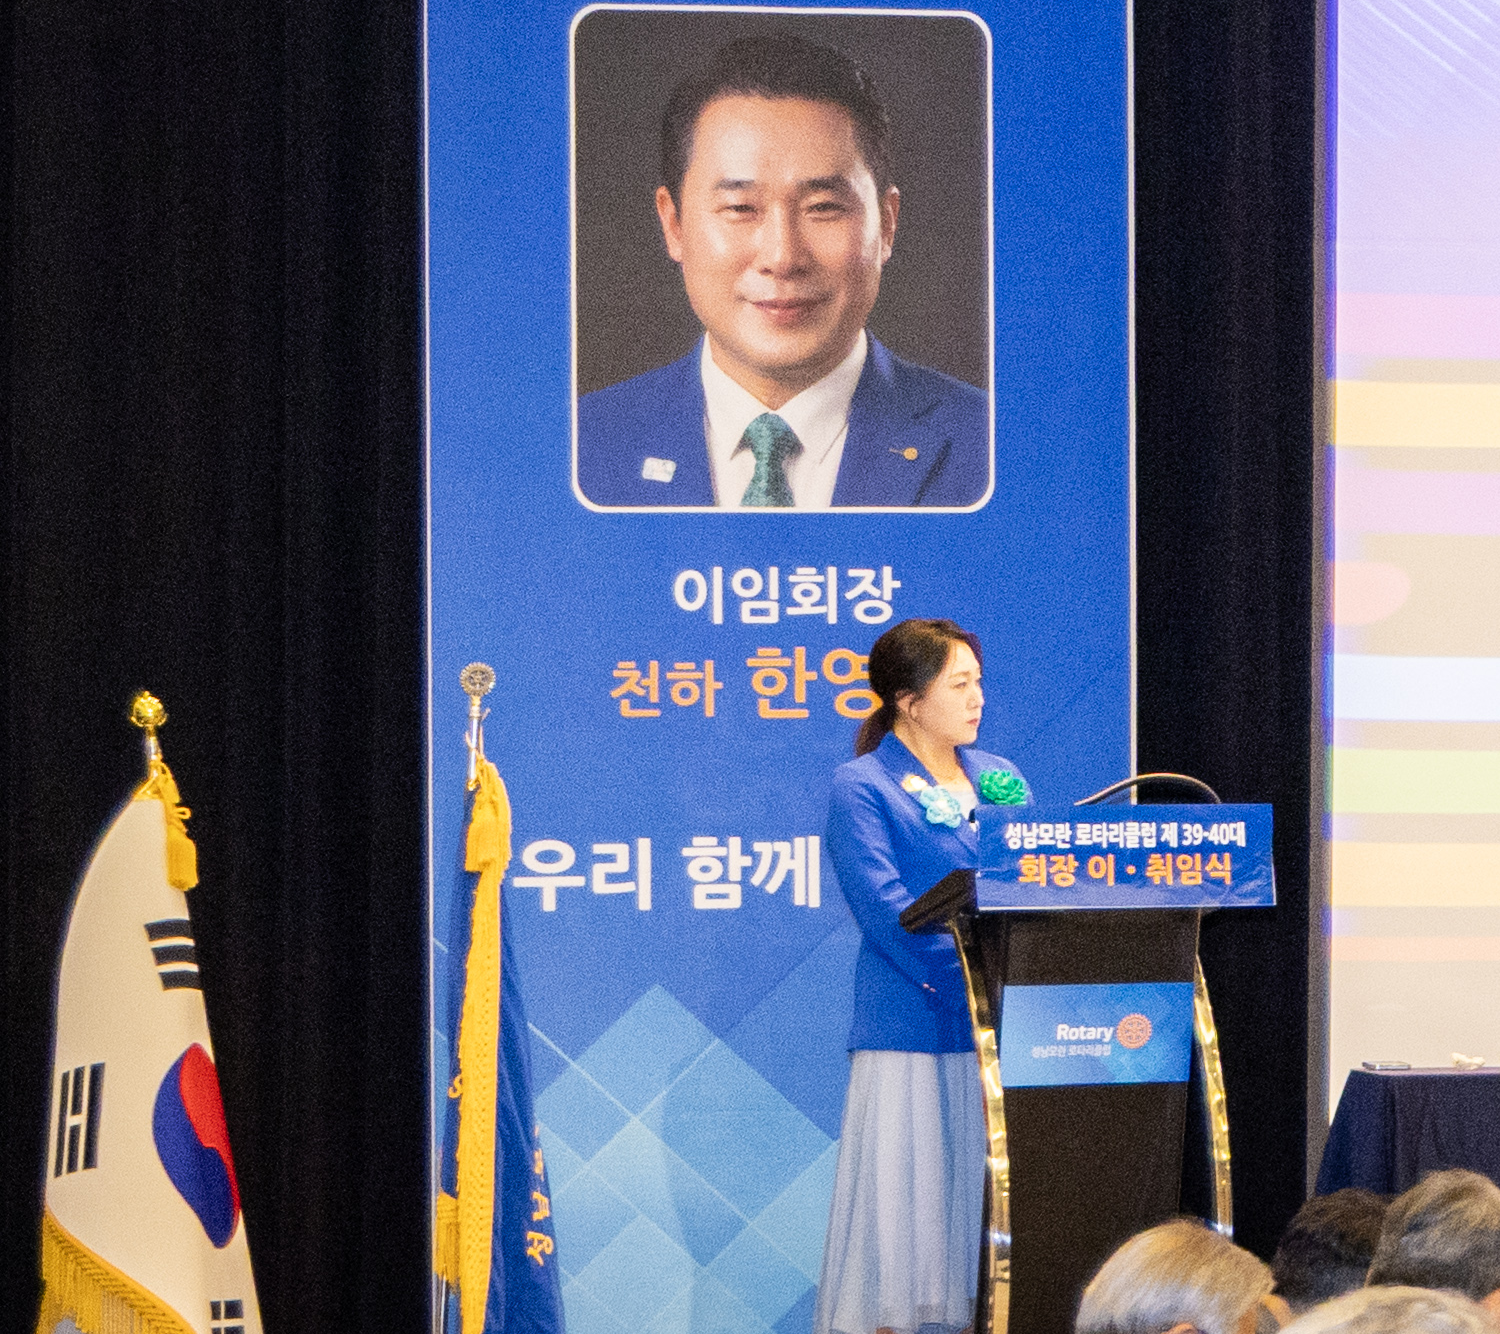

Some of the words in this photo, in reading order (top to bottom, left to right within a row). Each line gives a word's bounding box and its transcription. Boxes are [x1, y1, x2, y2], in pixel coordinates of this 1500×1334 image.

[674, 566, 901, 624] 이임회장
[611, 660, 723, 717] 천하
[746, 647, 882, 719] 한영
[1005, 823, 1072, 849] 성남모란
[1076, 822, 1156, 848] 로타리클럽
[1161, 823, 1177, 847] 제
[1182, 822, 1245, 846] 39-40대
[512, 838, 651, 911] 우리
[682, 836, 820, 909] 함께
[1019, 855, 1077, 886] 회장
[1088, 855, 1114, 886] 이
[1146, 854, 1230, 885] 취임식
[1056, 1024, 1113, 1041] Rotary
